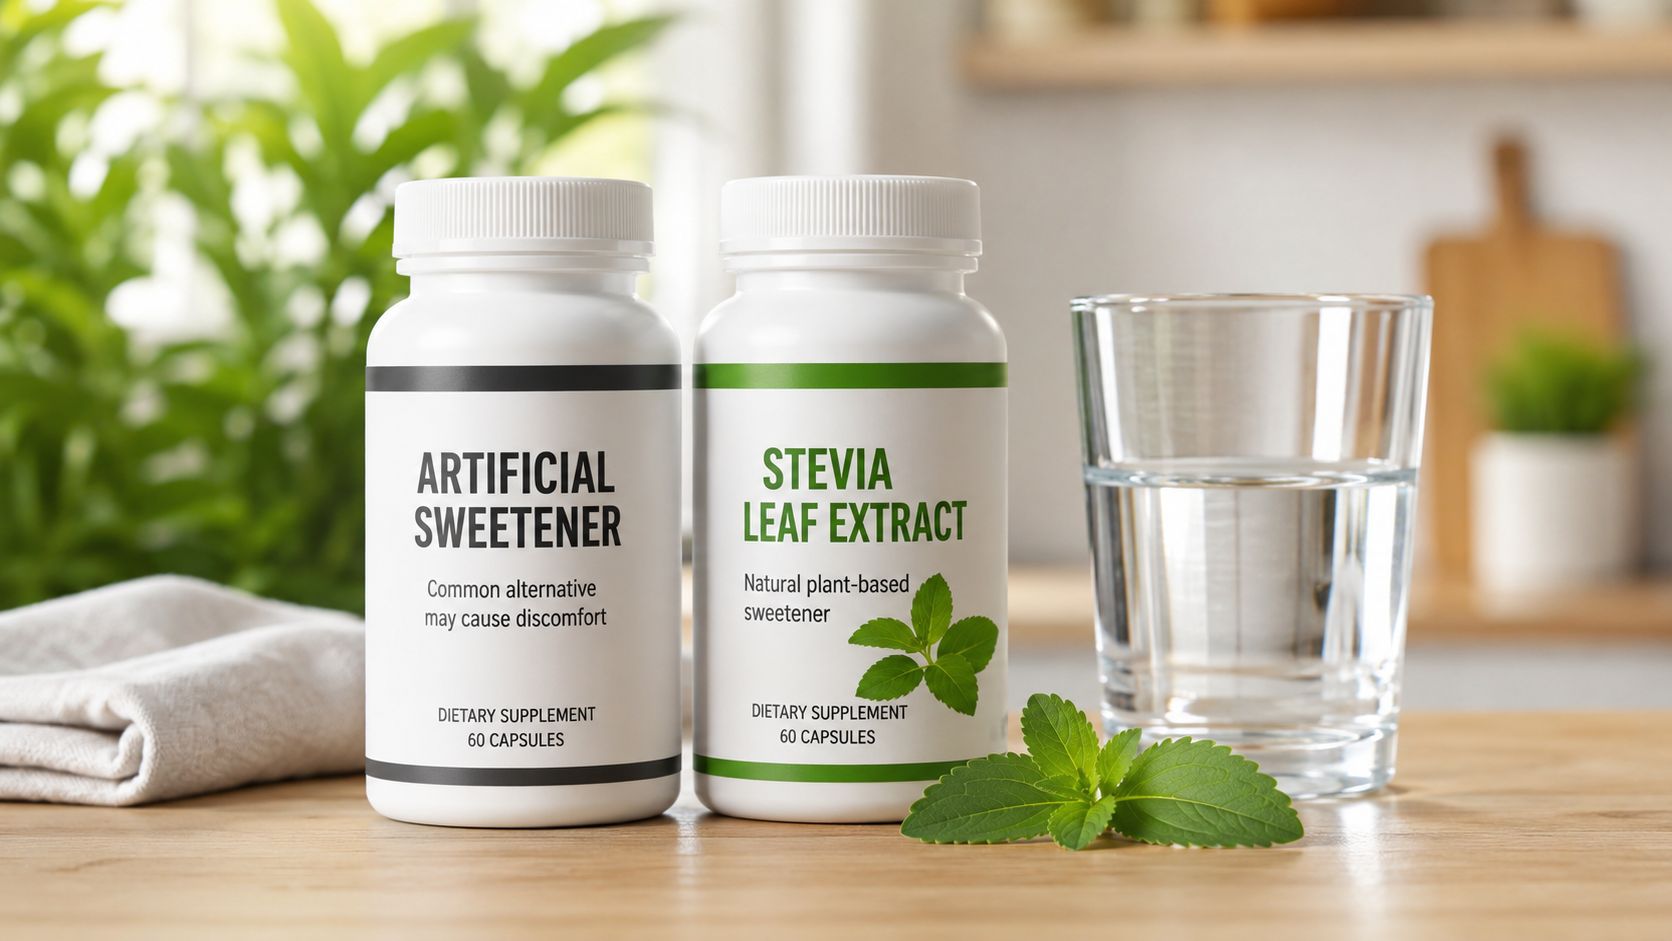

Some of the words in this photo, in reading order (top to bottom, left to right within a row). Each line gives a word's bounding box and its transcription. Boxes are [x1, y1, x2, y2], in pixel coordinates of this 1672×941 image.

[417, 451, 615, 494] ARTIFICIAL
[763, 447, 893, 490] STEVIA
[415, 505, 621, 548] SWEETENER
[744, 502, 818, 543] LEAF
[830, 501, 967, 543] EXTRACT
[428, 580, 500, 598] Common
[506, 579, 596, 598] alternative
[745, 573, 800, 593] Natural
[807, 573, 909, 597] plant-based
[425, 611, 456, 631] may
[462, 611, 510, 628] cause
[516, 607, 607, 627] discomfort
[745, 605, 830, 623] sweetener
[439, 707, 496, 723] DIETARY
[500, 706, 596, 723] SUPPLEMENT
[752, 703, 807, 719] DIETARY
[812, 705, 908, 720] SUPPLEMENT
[468, 733, 485, 748] 60
[490, 732, 564, 748] CAPSULES
[780, 729, 796, 744] 60
[801, 730, 875, 745] CAPSULES
